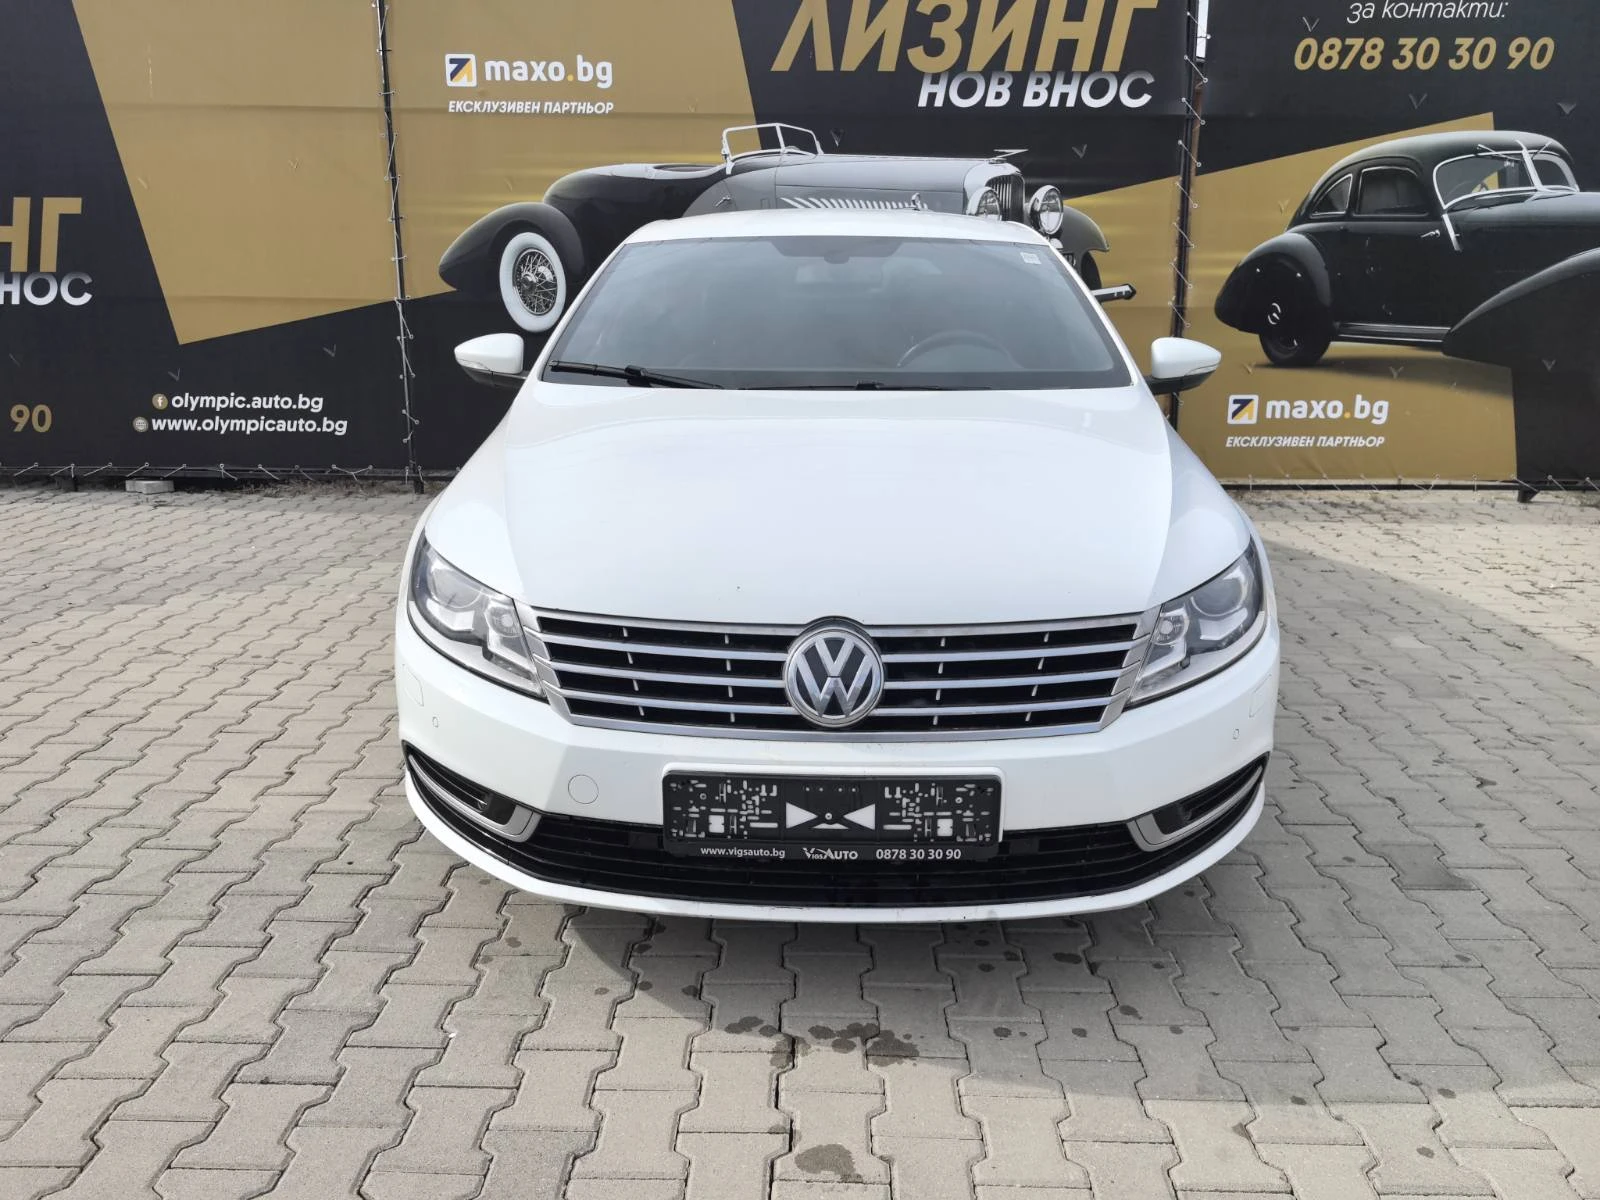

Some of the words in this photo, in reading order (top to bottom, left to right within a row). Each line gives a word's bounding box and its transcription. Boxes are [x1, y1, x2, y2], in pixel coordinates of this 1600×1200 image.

[1347, 1, 1375, 23] за
[1381, 0, 1508, 19] контакти:
[770, 0, 1159, 73] ЛИЗИНГ
[1294, 37, 1385, 71] 0878
[1392, 37, 1440, 71] 30
[1448, 37, 1497, 71] 30
[1506, 36, 1555, 71] 90
[484, 54, 613, 89] maxo.bg
[917, 71, 1014, 108] НОВ
[1022, 70, 1155, 108] ВНОС
[448, 100, 540, 113] ЕКСКЛУЗИВЕН
[543, 101, 614, 114] ПАРТНЬОР
[171, 393, 324, 412] olympic.auto.bg
[1265, 394, 1389, 425] maxo.bg
[10, 404, 52, 433] 90
[151, 416, 348, 435] www.olympicauto.bg
[1225, 436, 1315, 448] ЕКСКЛУЗИВЕН
[1317, 436, 1385, 448] ПАРТНЬОР
[700, 846, 786, 859] www.vigsauto.bg
[875, 848, 907, 860] 0878
[909, 848, 925, 860] 30
[927, 848, 943, 860] 30
[945, 848, 962, 860] 90
